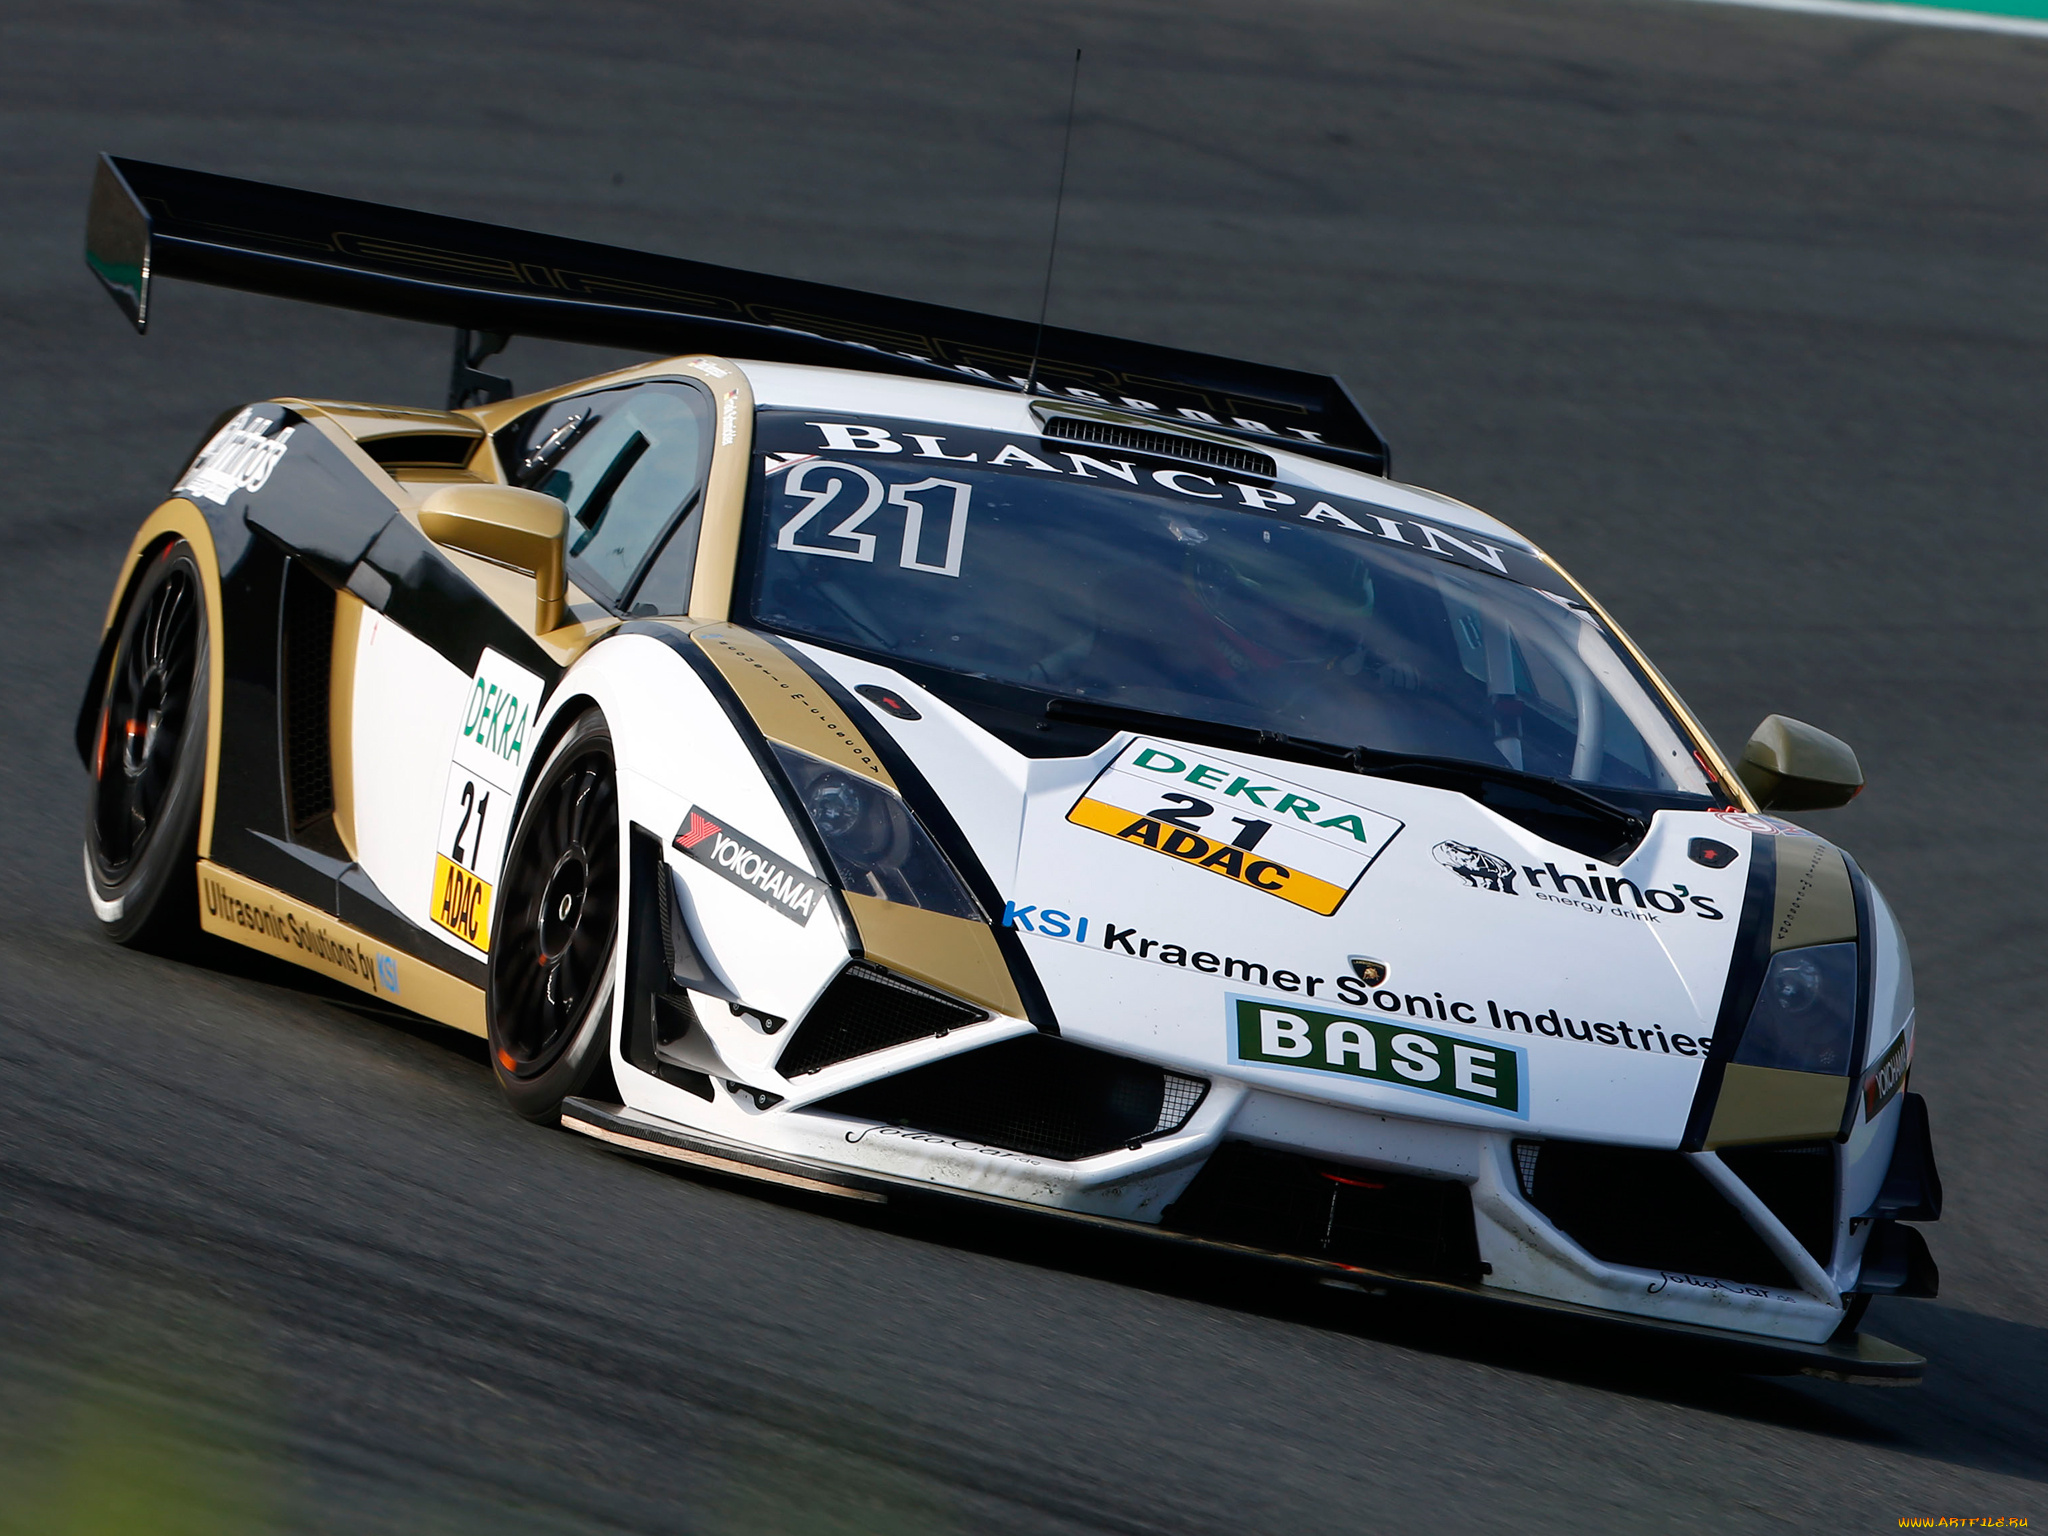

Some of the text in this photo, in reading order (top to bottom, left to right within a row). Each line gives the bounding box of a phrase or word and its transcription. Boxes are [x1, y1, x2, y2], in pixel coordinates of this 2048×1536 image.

[776, 459, 973, 578] 21
[804, 421, 1509, 575] BLANCPAIN
[463, 676, 530, 767] DEKRA
[452, 780, 490, 872] 21
[1132, 747, 1368, 844] DEKRA
[1146, 792, 1273, 852] 21
[710, 832, 816, 917] YOKOHAMA
[1116, 818, 1291, 891] ADAC
[1521, 862, 1724, 921] rhino's
[203, 877, 400, 995] Ultrasonic Solutions by KSI
[440, 865, 482, 942] ADAC
[1535, 892, 1662, 924] energy drink
[1001, 899, 1713, 1057] KSI Kraemer Sonic Industries
[1258, 1008, 1498, 1099] BASE
